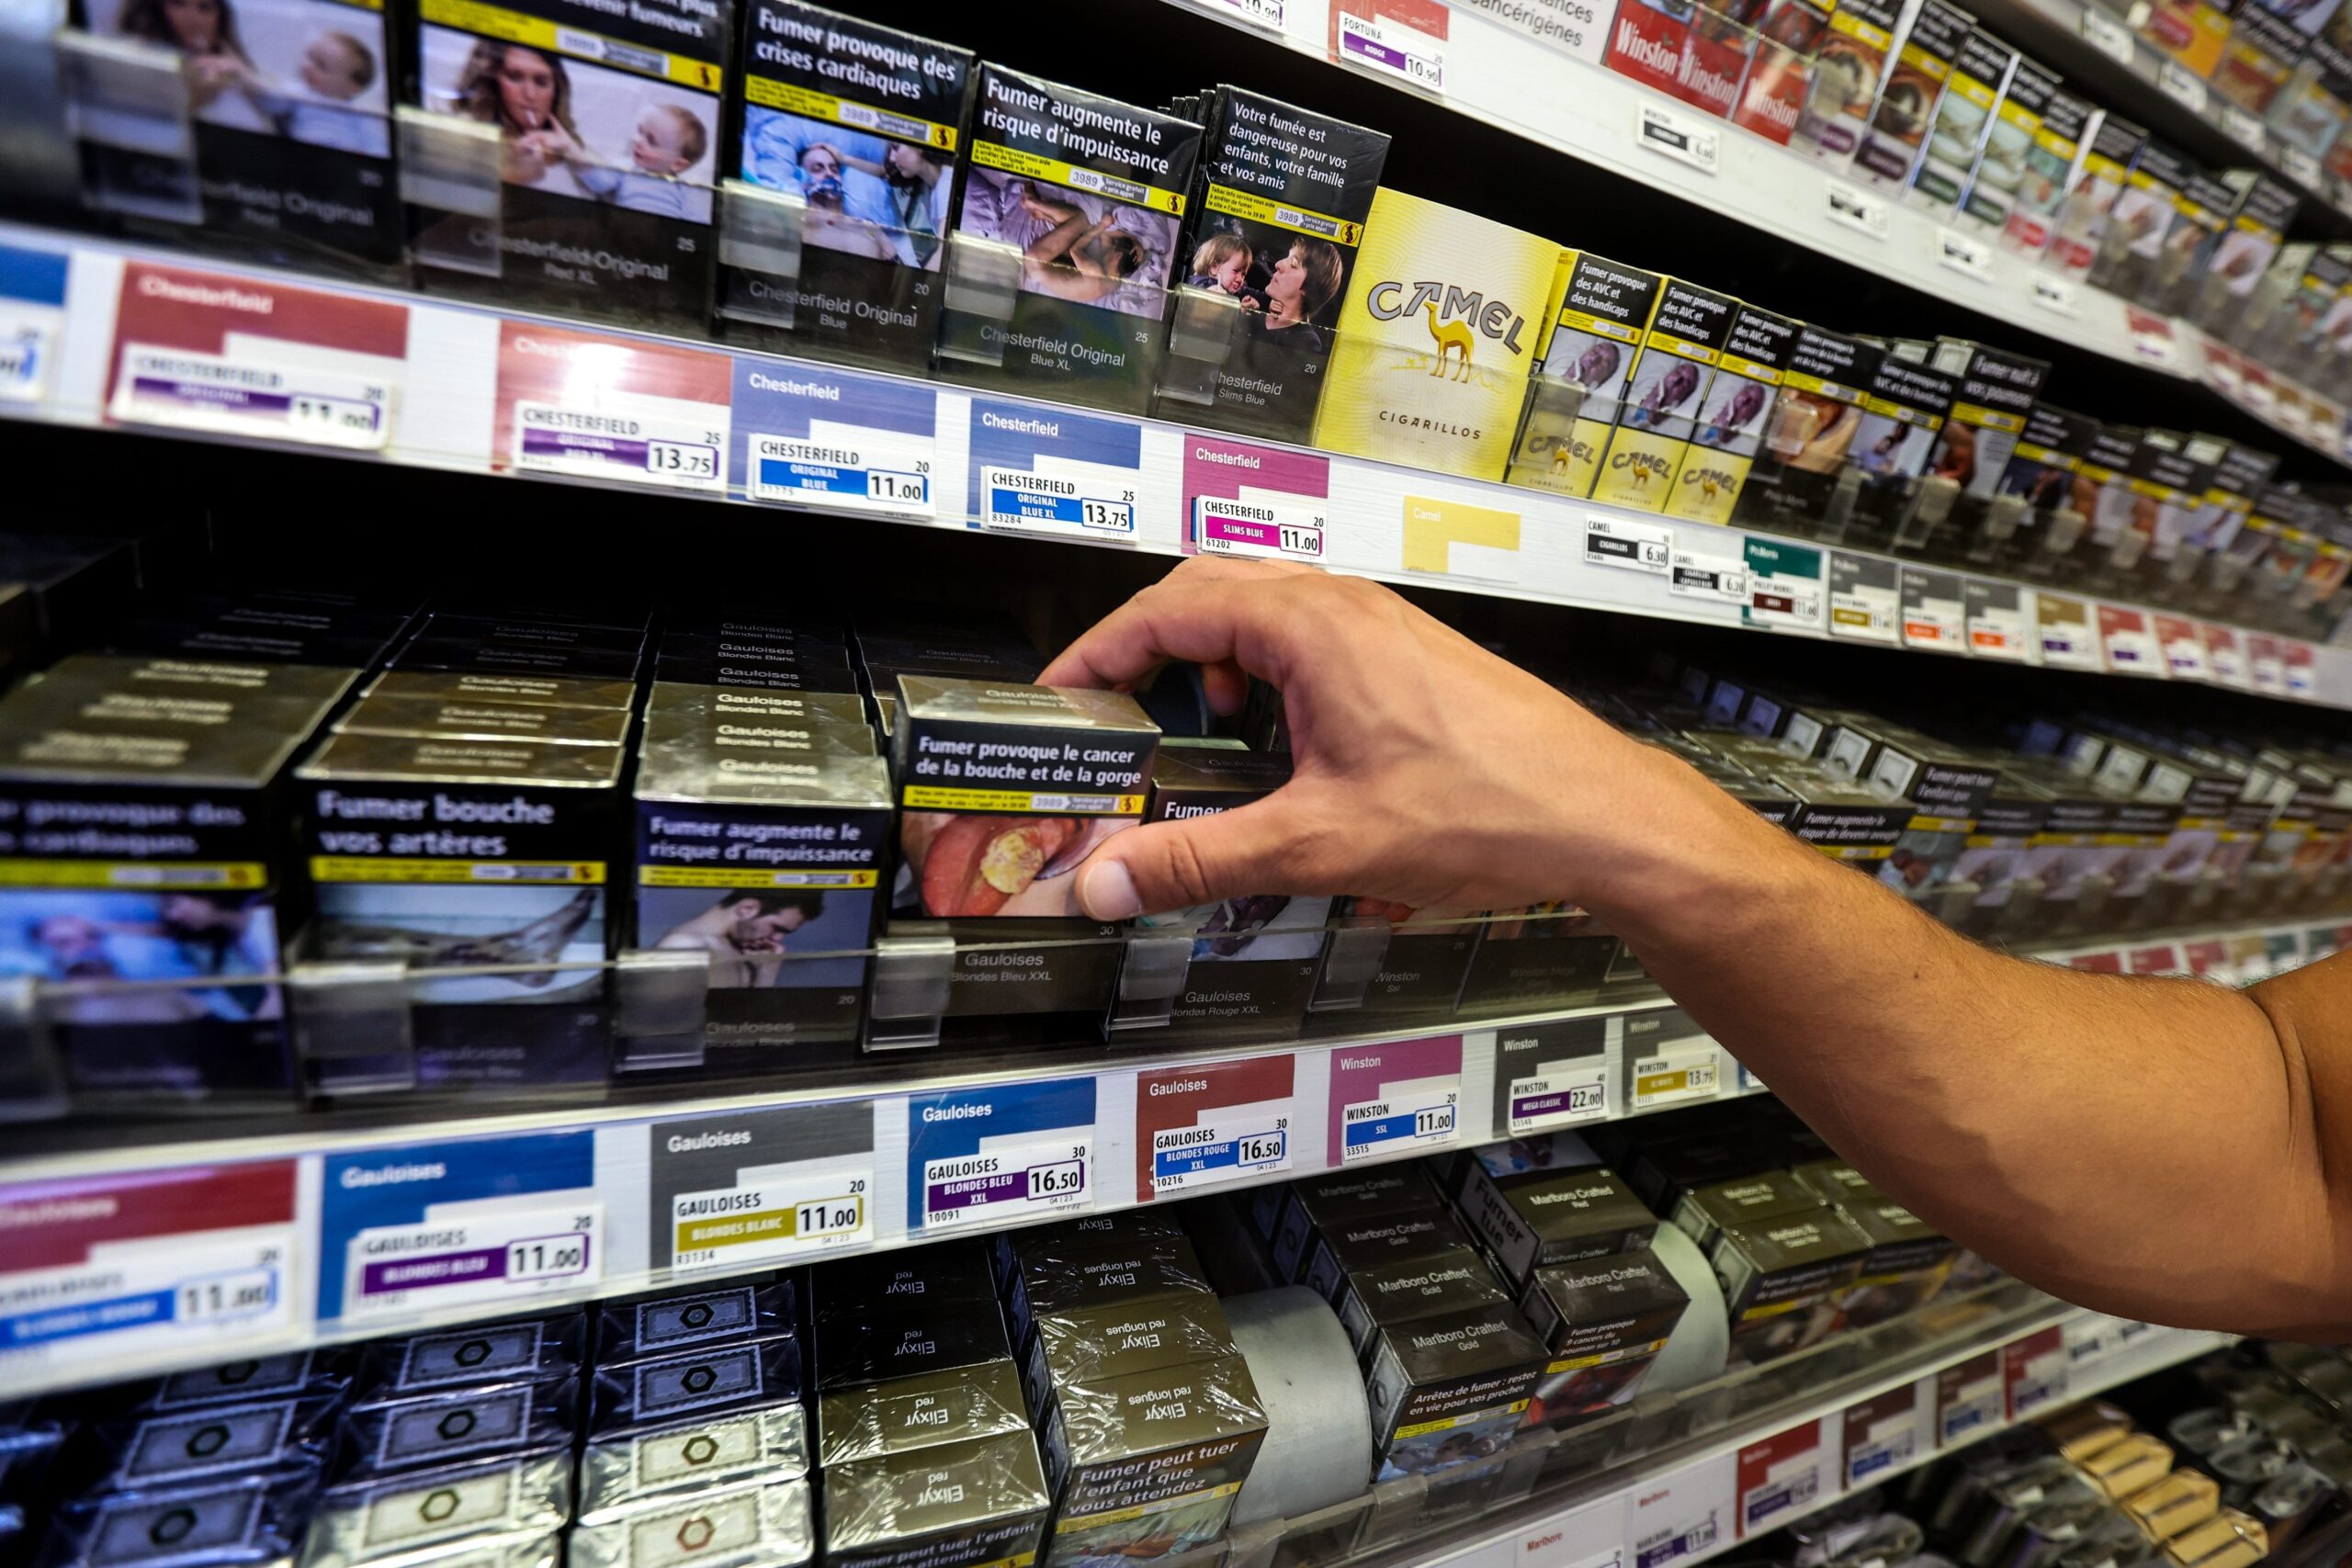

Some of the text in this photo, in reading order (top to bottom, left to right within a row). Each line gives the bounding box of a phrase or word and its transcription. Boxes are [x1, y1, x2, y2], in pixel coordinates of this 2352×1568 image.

[628, 3, 704, 39] fumeurs
[1343, 17, 1383, 41] FORTUNA
[758, 7, 956, 82] Fumer provoque des
[1615, 17, 1678, 76] Winston
[755, 40, 814, 72] crises
[816, 59, 922, 100] cardiaques
[1676, 51, 1736, 107] Winston
[986, 77, 1162, 147] Fumer augmente le
[1745, 77, 1799, 130] Winston
[1234, 102, 1327, 143] Votre fumée est
[982, 107, 1170, 176] risque d'impuissance
[1228, 122, 1348, 170] dangereuse pour vos
[1219, 161, 1286, 191] et vos amis
[1224, 142, 1345, 189] enfants, votre famille
[1277, 210, 1299, 223] 3989
[595, 251, 669, 281] Original
[1579, 261, 1647, 292] Fumer provoque
[914, 281, 930, 296] 20
[1575, 276, 1621, 299] des AVC et
[749, 279, 918, 328] Chesterfield Original
[1570, 292, 1630, 319] des handicaps
[820, 313, 847, 330] Blue
[1366, 280, 1526, 356] CAMEL
[979, 324, 1126, 367] Chesterfield Original
[1135, 331, 1148, 344] 25
[1030, 353, 1072, 371] Blue XL
[1304, 363, 1317, 375] 20
[748, 372, 840, 402] Chesterfield
[1218, 388, 1265, 406] Slims Blue
[523, 408, 640, 436] CHESTERFIELD
[982, 412, 1058, 437] Chesterfield
[1379, 410, 1482, 441] CIGARILLOS
[652, 446, 711, 475] 13.75
[760, 440, 860, 466] CHESTERFIELD
[1195, 447, 1260, 470] Chesterfield
[789, 463, 838, 479] ORIGINAL
[915, 460, 930, 474] 20
[870, 474, 922, 502] 11.00
[991, 471, 1075, 495] CHESTERFIELD
[1683, 467, 1738, 495] CAMEL
[1017, 492, 1058, 508] ORIGINAL
[1122, 490, 1135, 502] 25
[1021, 505, 1056, 520] BLUE XL
[1085, 502, 1128, 527] 13.75
[1204, 500, 1274, 522] CHESTERFIELD
[1313, 515, 1324, 528] 20
[1412, 506, 1442, 523] Camel
[1223, 524, 1264, 539] SLIMS BLUE
[1588, 519, 1611, 534] CAMEL
[1205, 538, 1231, 550] 61202
[1282, 528, 1317, 552] 11.00
[1673, 553, 1695, 567] CAMEL
[717, 693, 803, 707] Gauloises
[717, 724, 810, 739] Gauloises
[919, 736, 1136, 764] Fumer provoque le cancer
[915, 757, 1142, 787] de la bouche et de la gorge
[317, 789, 556, 825] Fumer bouche
[649, 816, 862, 843] Fumer augmente le
[320, 829, 508, 856] vos artères
[649, 840, 721, 863] risque
[964, 952, 1045, 967] Gauloises
[1184, 990, 1251, 1004] Gauloises
[1208, 1005, 1261, 1019] Rouge XXL
[1503, 1037, 1540, 1053] Winston
[1340, 1055, 1382, 1072] Winston
[1149, 1078, 1208, 1098] Gauloises
[1446, 1093, 1457, 1104] 20
[1513, 1080, 1550, 1096] WINSTON
[1572, 1090, 1601, 1110] 22.00
[922, 1102, 993, 1123] Gauloises
[1346, 1103, 1390, 1122] WINSTON
[1418, 1112, 1451, 1133] 11.00
[1275, 1118, 1288, 1131] 30
[1375, 1124, 1388, 1135] SSL
[667, 1130, 752, 1154] Gauloises
[1156, 1128, 1216, 1149] GAULOISES
[1072, 1145, 1086, 1159] 30
[1166, 1144, 1231, 1163] BLONDES ROUGE
[1240, 1139, 1281, 1162] 16.50
[1346, 1144, 1370, 1156] 33515
[340, 1160, 447, 1189] Gauloises
[928, 1157, 999, 1181] GAULOISES
[1191, 1160, 1205, 1171] XXL
[849, 1179, 865, 1194] 20
[944, 1175, 1013, 1196] BLONDES BLEU
[1030, 1169, 1079, 1194] 16.50
[1156, 1174, 1184, 1189] 10216
[677, 1192, 762, 1218] GAULOISES
[969, 1193, 989, 1206] XXL
[799, 1205, 857, 1234] 11.00
[928, 1209, 960, 1224] 10091
[691, 1216, 784, 1242] BLONDES BLANC
[1084, 1260, 1141, 1274] red longues
[886, 1281, 925, 1294] Elixyr
[1098, 1273, 1136, 1286] Elixyr
[1378, 1268, 1470, 1293] Marlboro Crafted
[1106, 1319, 1166, 1336] red longues
[1412, 1320, 1509, 1348] Marlboro Crafted
[894, 1341, 936, 1356] Elixyr
[1121, 1334, 1160, 1349] Elixyr
[1457, 1339, 1479, 1352] Gold
[1128, 1385, 1192, 1405] red longues
[1413, 1370, 1538, 1405] Arrêtez de fumer restez
[904, 1408, 949, 1427] Elixyr
[1145, 1402, 1187, 1421] Elixyr
[1080, 1441, 1238, 1483] Fumer peut tuer
[1157, 1468, 1193, 1485] que
[1069, 1478, 1205, 1515] vous attendez
[1527, 1533, 1563, 1551] Marlboro
